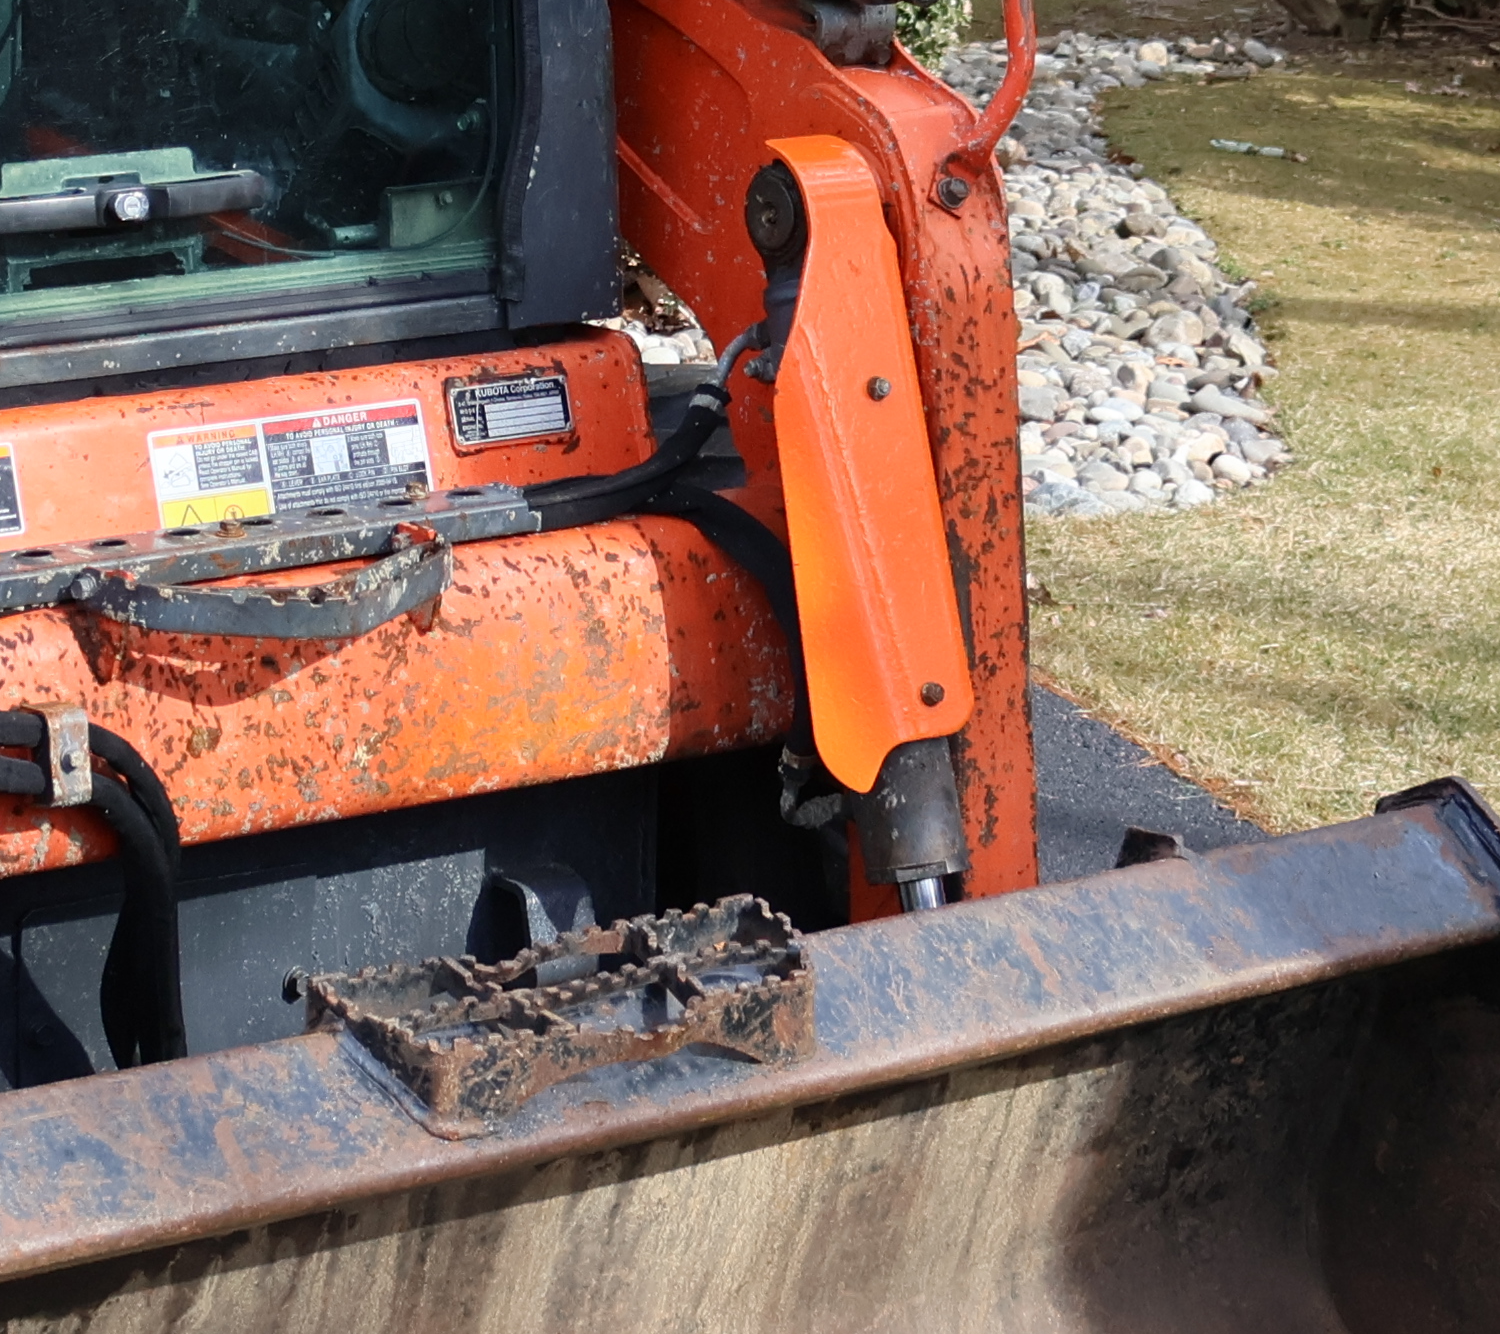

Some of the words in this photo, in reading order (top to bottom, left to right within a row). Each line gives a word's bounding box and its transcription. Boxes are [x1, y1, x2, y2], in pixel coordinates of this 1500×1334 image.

[475, 386, 510, 398] KUBOTA
[510, 381, 555, 394] Corporation
[323, 411, 368, 426] DANGER
[187, 429, 236, 443] WARNING
[286, 432, 294, 440] TO
[295, 430, 313, 439] AVOID
[314, 426, 345, 437] PERSONAL
[345, 423, 365, 433] INJURY
[366, 422, 375, 430] OR
[203, 442, 221, 450] AVOID
[222, 437, 252, 447] PERSONAL
